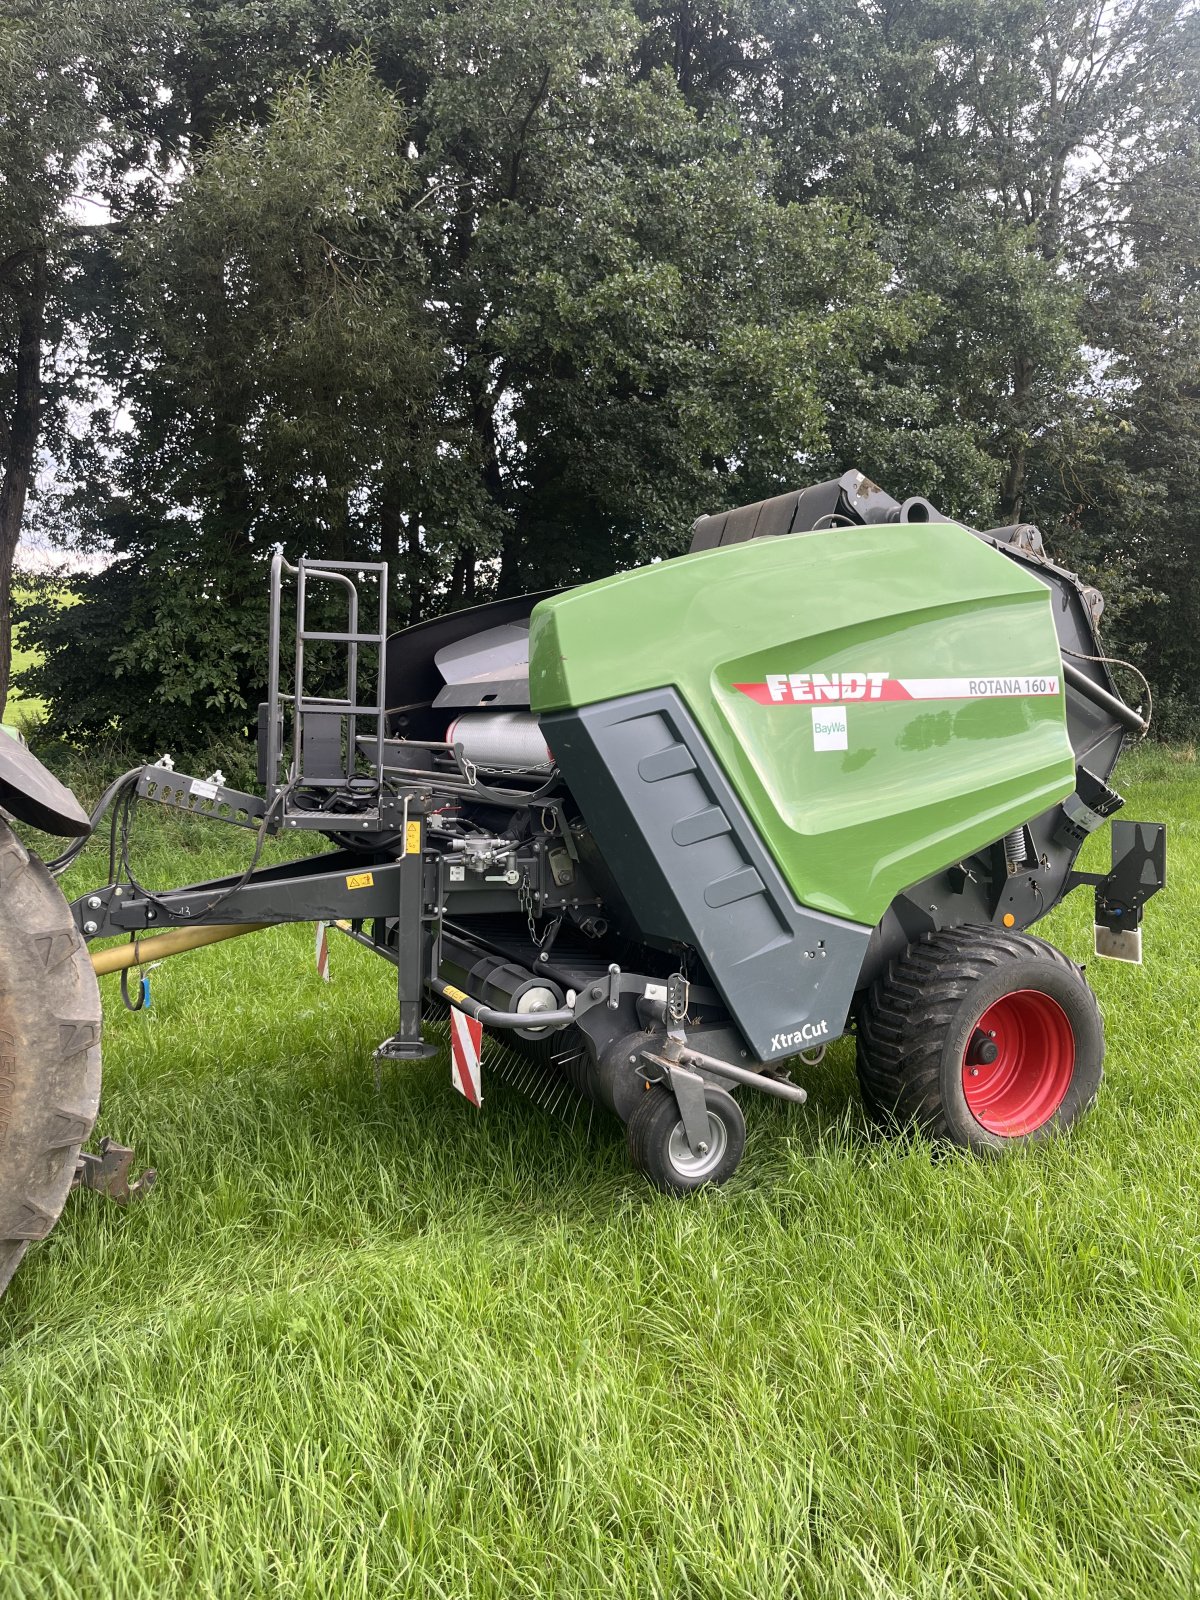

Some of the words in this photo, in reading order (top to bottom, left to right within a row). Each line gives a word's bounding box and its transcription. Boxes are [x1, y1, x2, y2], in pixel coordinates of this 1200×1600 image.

[766, 672, 889, 701] FENDT
[969, 680, 1021, 694] ROTANA
[1025, 680, 1046, 693] 160
[814, 722, 846, 735] BayWa
[771, 1019, 828, 1052] XtraCut
